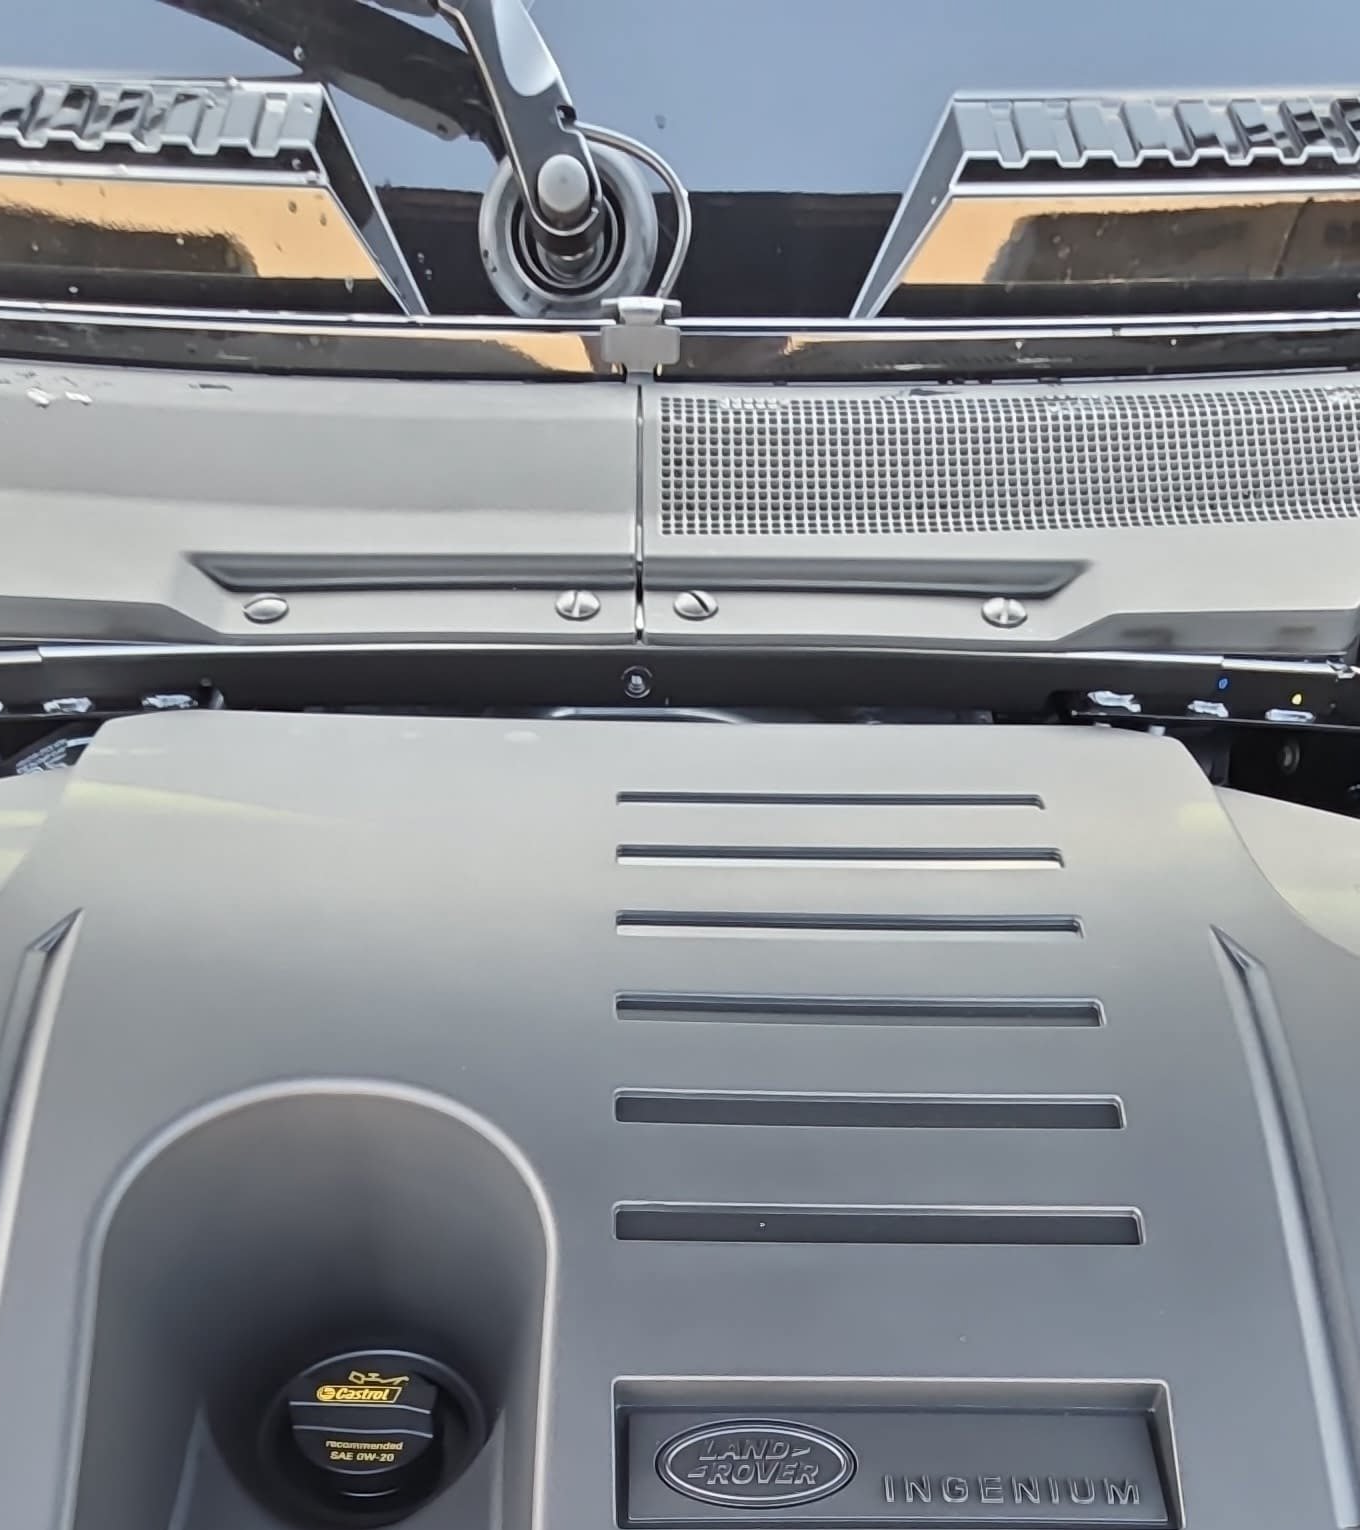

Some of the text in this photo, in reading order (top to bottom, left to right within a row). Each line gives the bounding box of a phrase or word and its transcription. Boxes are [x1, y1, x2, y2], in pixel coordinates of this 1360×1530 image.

[335, 1387, 390, 1401] Castrol
[325, 1440, 404, 1451] recommended
[698, 1438, 792, 1460] LAND
[330, 1451, 395, 1462] SAE 0W-20
[706, 1461, 820, 1486] ROVER
[883, 1474, 1141, 1505] INGENIUM
